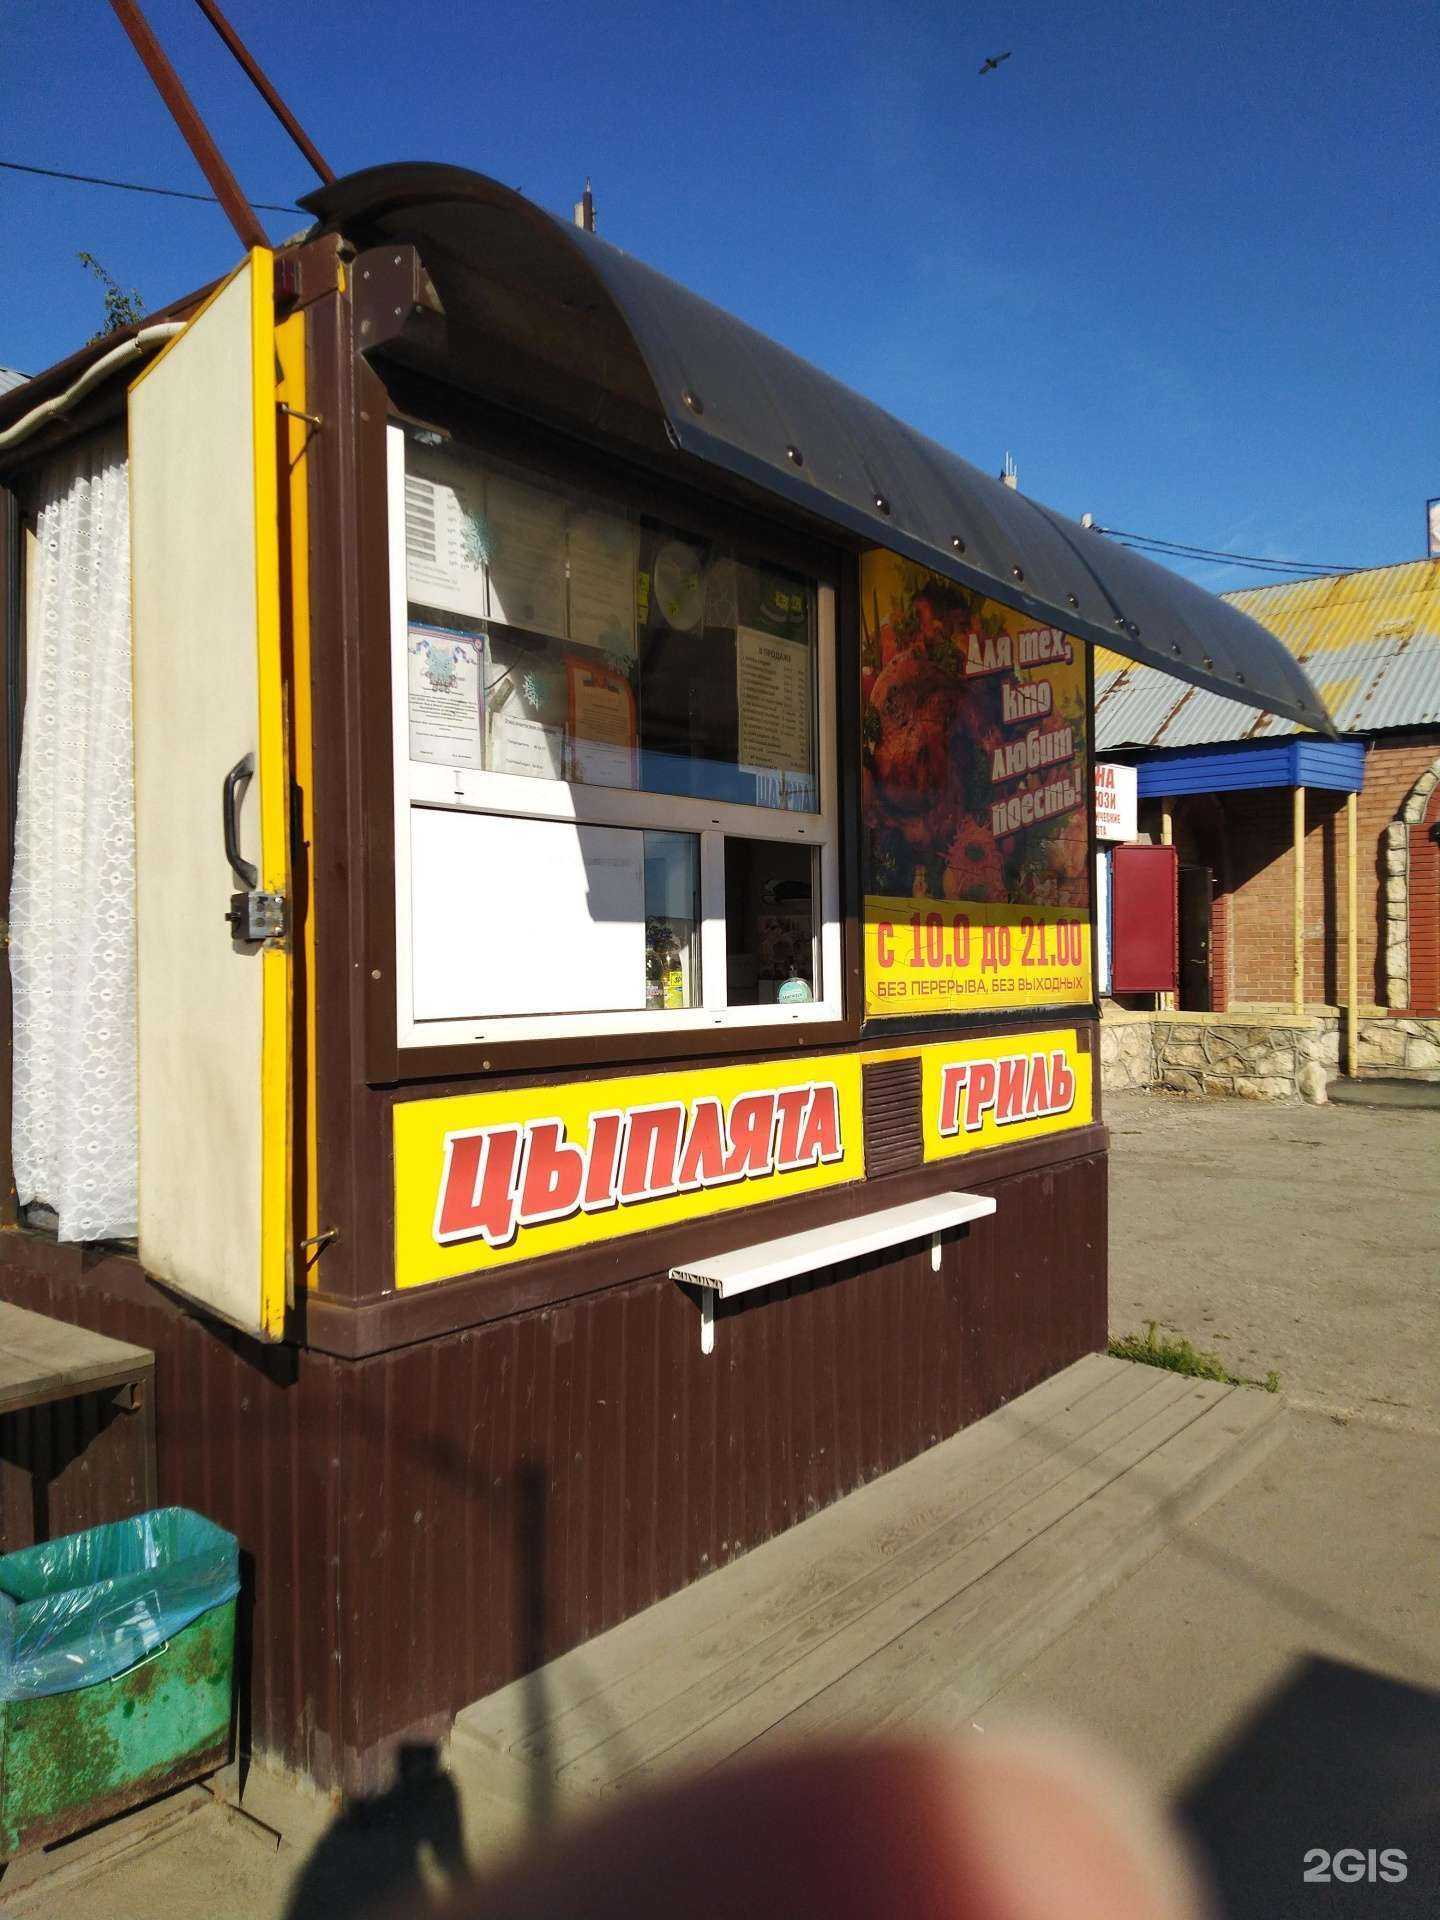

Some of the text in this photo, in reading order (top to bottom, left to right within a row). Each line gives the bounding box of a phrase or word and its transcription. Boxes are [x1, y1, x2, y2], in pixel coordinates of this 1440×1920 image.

[991, 727, 1072, 781] любит
[991, 767, 1082, 836] поесть!
[910, 911, 970, 968] 10.0
[981, 924, 1010, 974] до
[1021, 916, 1082, 967] 21.00
[877, 976, 1083, 997] БЕЗ ПЕРЕРЫВА, БЕЗ ВЫХОДНЫХ
[433, 1049, 1076, 1246] ЦЫПЛЯТА ГРИЛЬ
